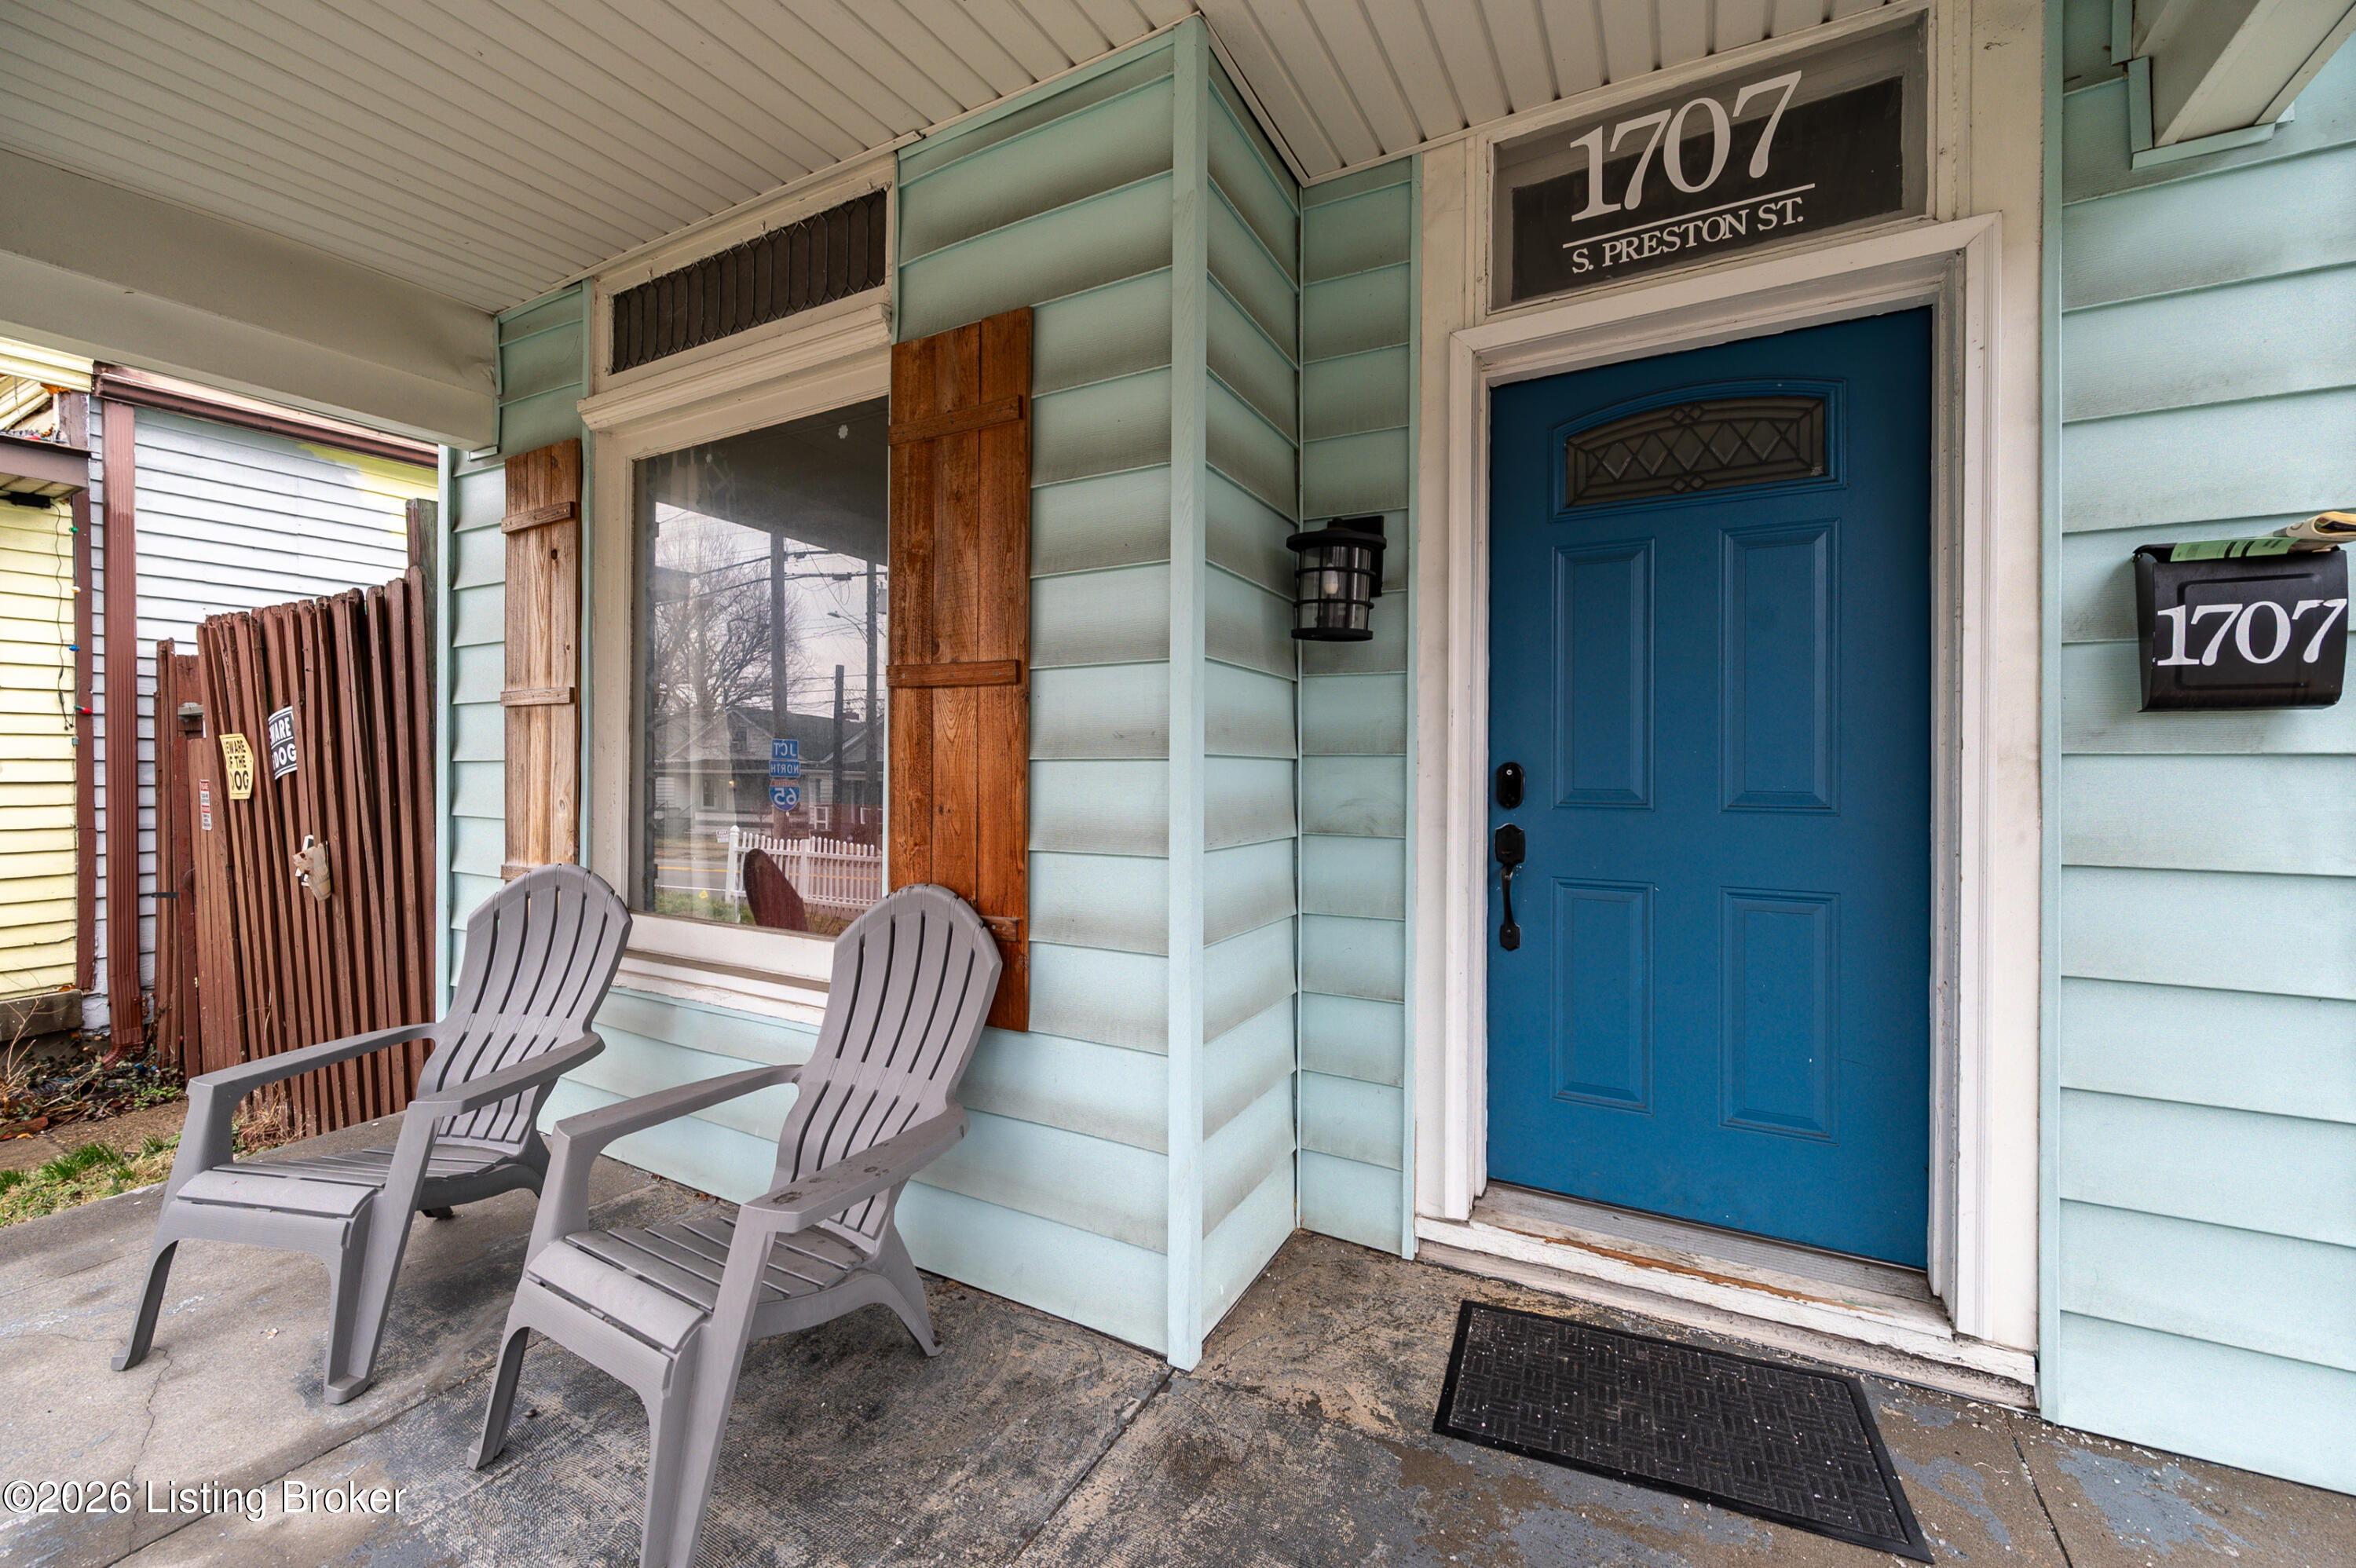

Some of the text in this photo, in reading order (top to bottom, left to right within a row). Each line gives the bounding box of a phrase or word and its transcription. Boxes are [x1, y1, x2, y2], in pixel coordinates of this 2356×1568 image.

[1571, 70, 1802, 222] 1707
[1571, 197, 1805, 274] S. PRESTON ST.
[2157, 598, 2347, 667] 1707
[225, 740, 246, 754] EWARE
[269, 717, 292, 746] WARE
[234, 755, 247, 768] THE
